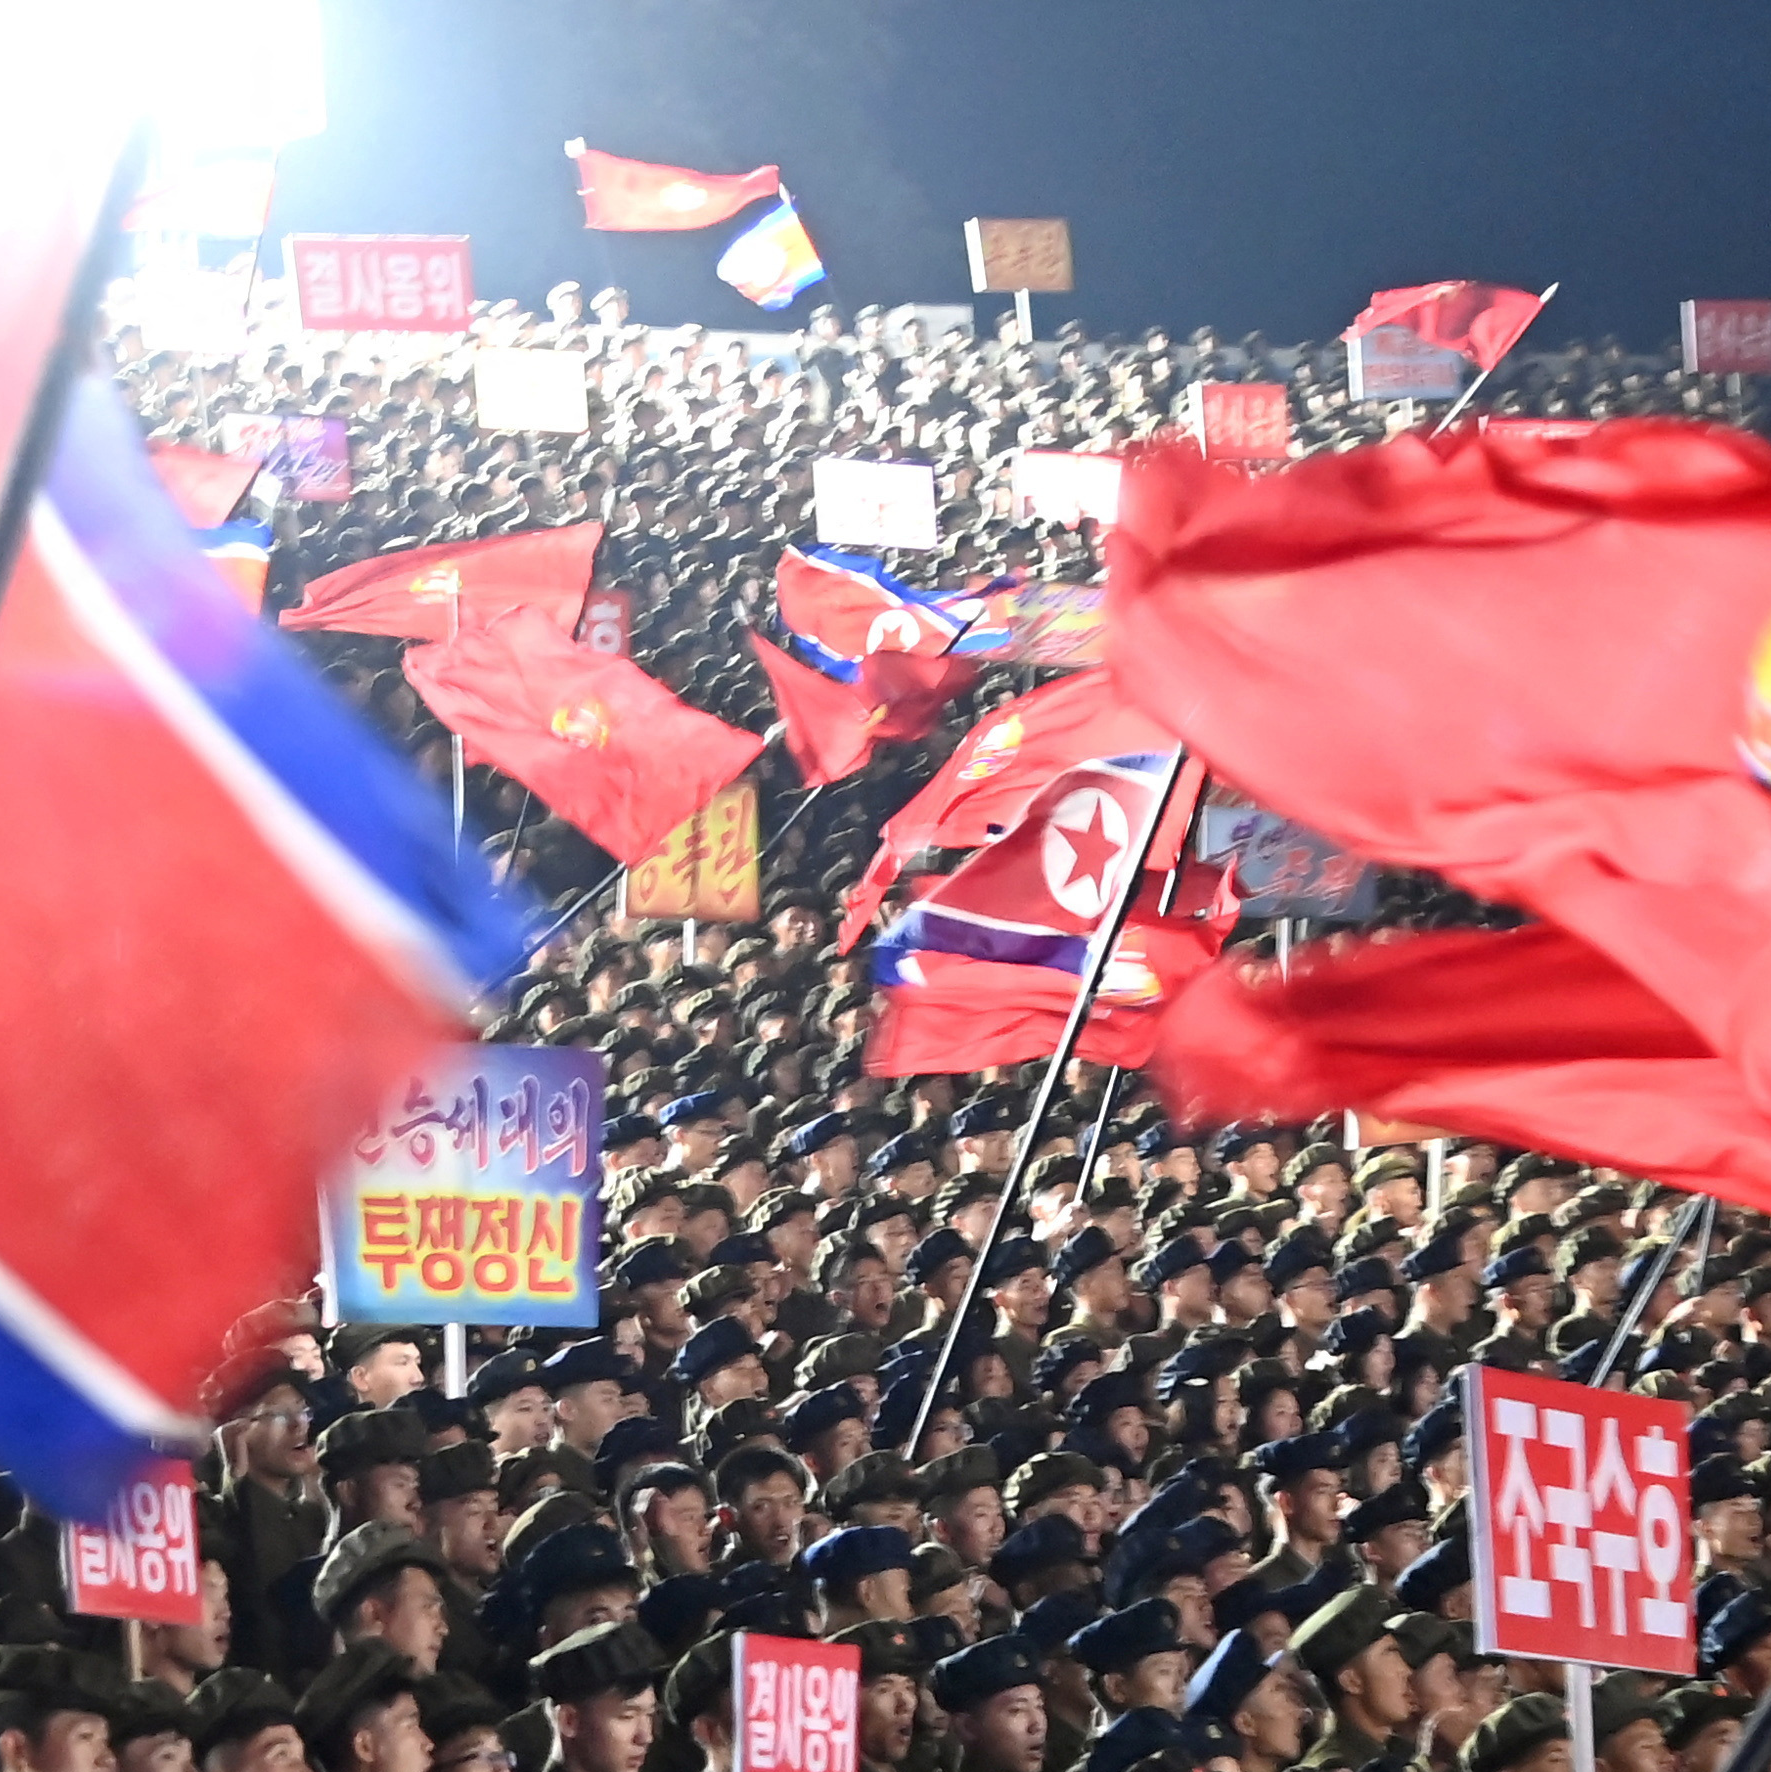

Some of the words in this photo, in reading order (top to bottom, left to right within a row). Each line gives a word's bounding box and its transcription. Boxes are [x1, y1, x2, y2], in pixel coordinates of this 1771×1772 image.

[354, 1074, 591, 1178] 승세대의
[360, 1192, 582, 1294] 투쟁정신
[1492, 1397, 1688, 1638] 조국수호
